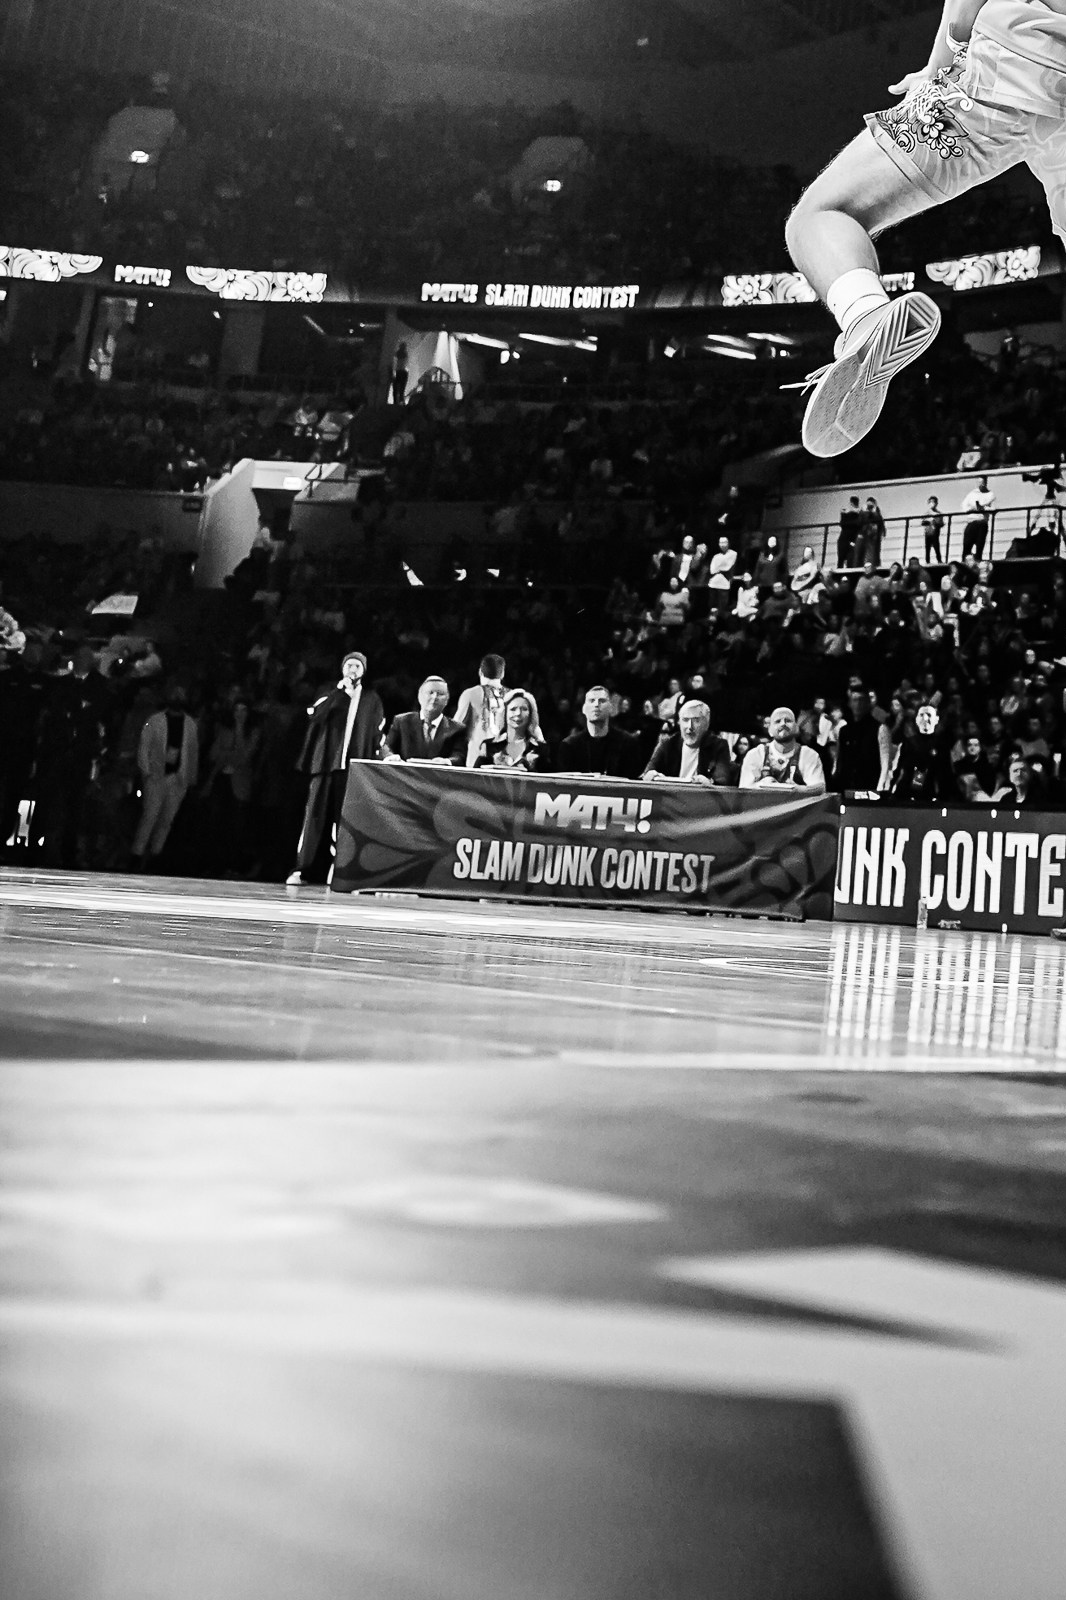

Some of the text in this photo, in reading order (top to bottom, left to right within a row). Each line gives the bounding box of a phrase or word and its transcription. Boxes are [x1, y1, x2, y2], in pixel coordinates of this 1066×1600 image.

[485, 284, 530, 307] SLAM
[530, 285, 572, 308] DUNK
[573, 285, 640, 308] CONTEST
[533, 792, 653, 834] МАТЧ!
[453, 837, 716, 894] SLAM DUNK CONTEST
